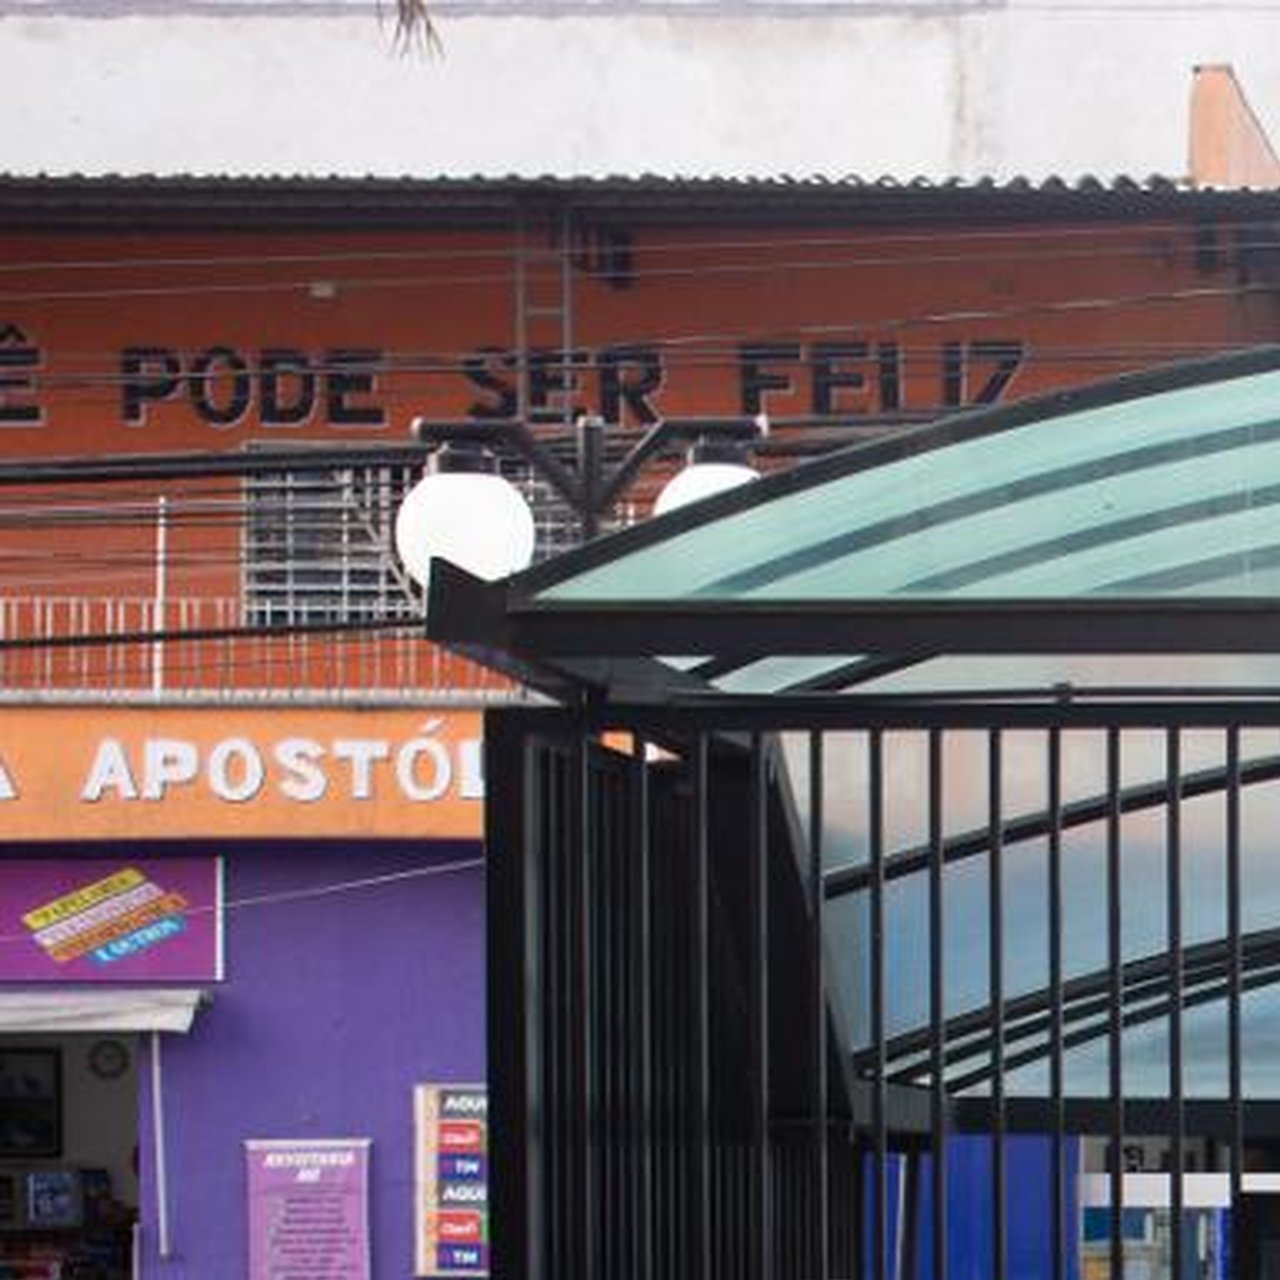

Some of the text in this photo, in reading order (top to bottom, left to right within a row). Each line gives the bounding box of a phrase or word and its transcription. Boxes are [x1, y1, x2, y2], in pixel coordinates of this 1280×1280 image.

[121, 346, 387, 426] PODE
[463, 346, 667, 424] SER
[739, 339, 1026, 414] FELIZ
